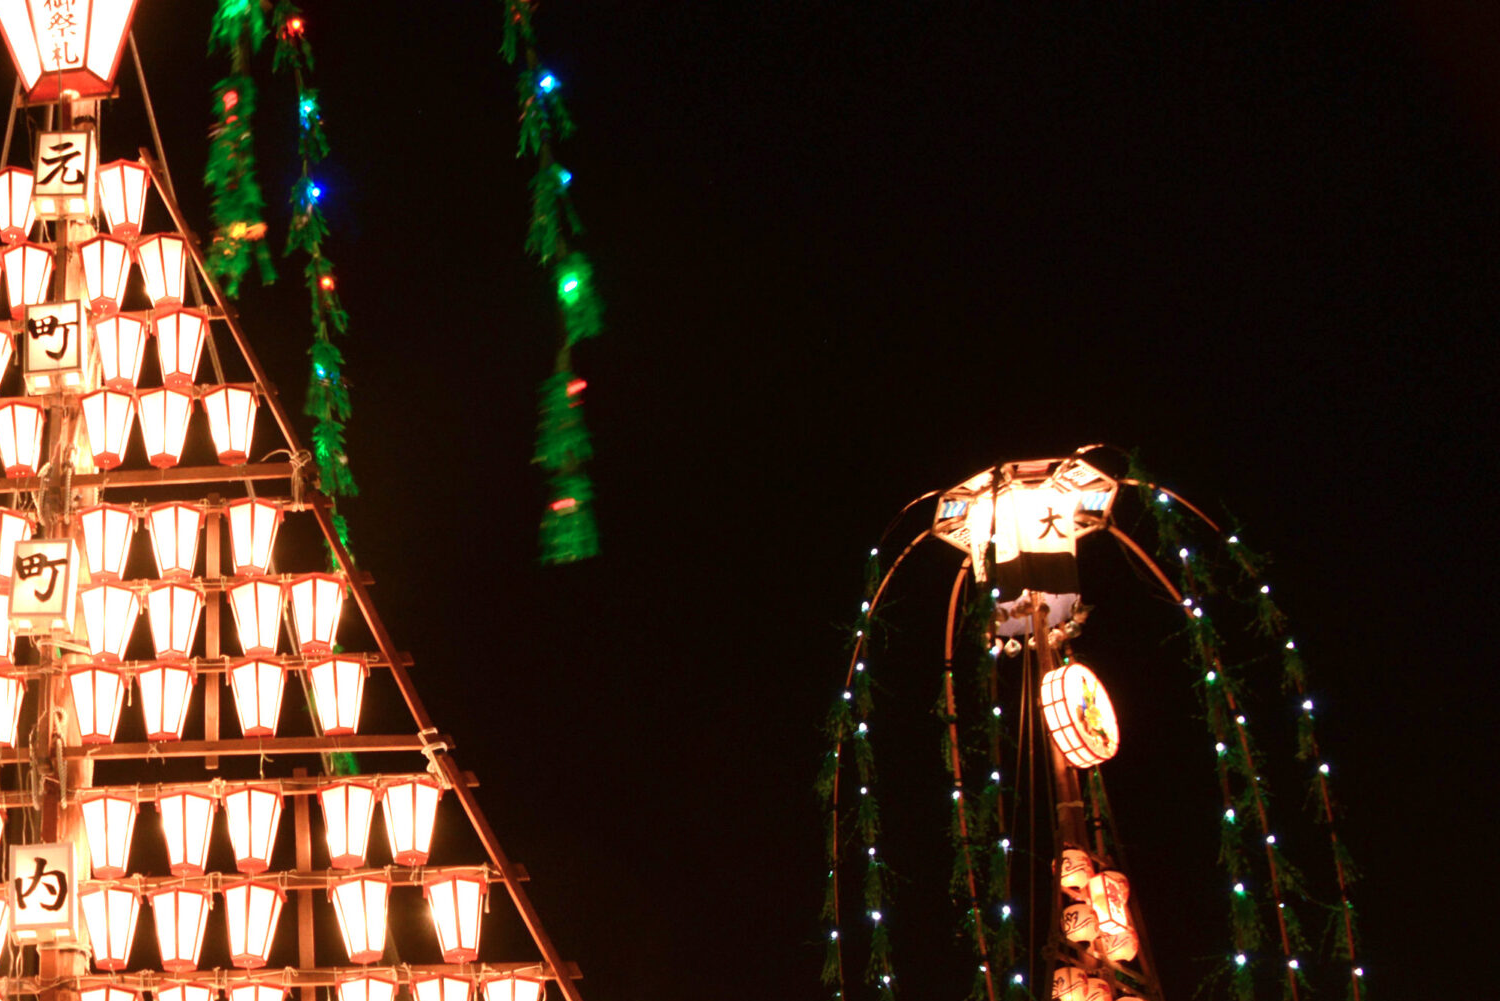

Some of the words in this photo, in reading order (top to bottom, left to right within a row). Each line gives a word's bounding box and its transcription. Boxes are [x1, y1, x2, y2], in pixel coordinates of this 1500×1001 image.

[37, 142, 85, 186] 元
[27, 314, 79, 361] 町
[1038, 507, 1067, 539] 大
[15, 552, 69, 603] 町
[15, 857, 68, 912] 内
